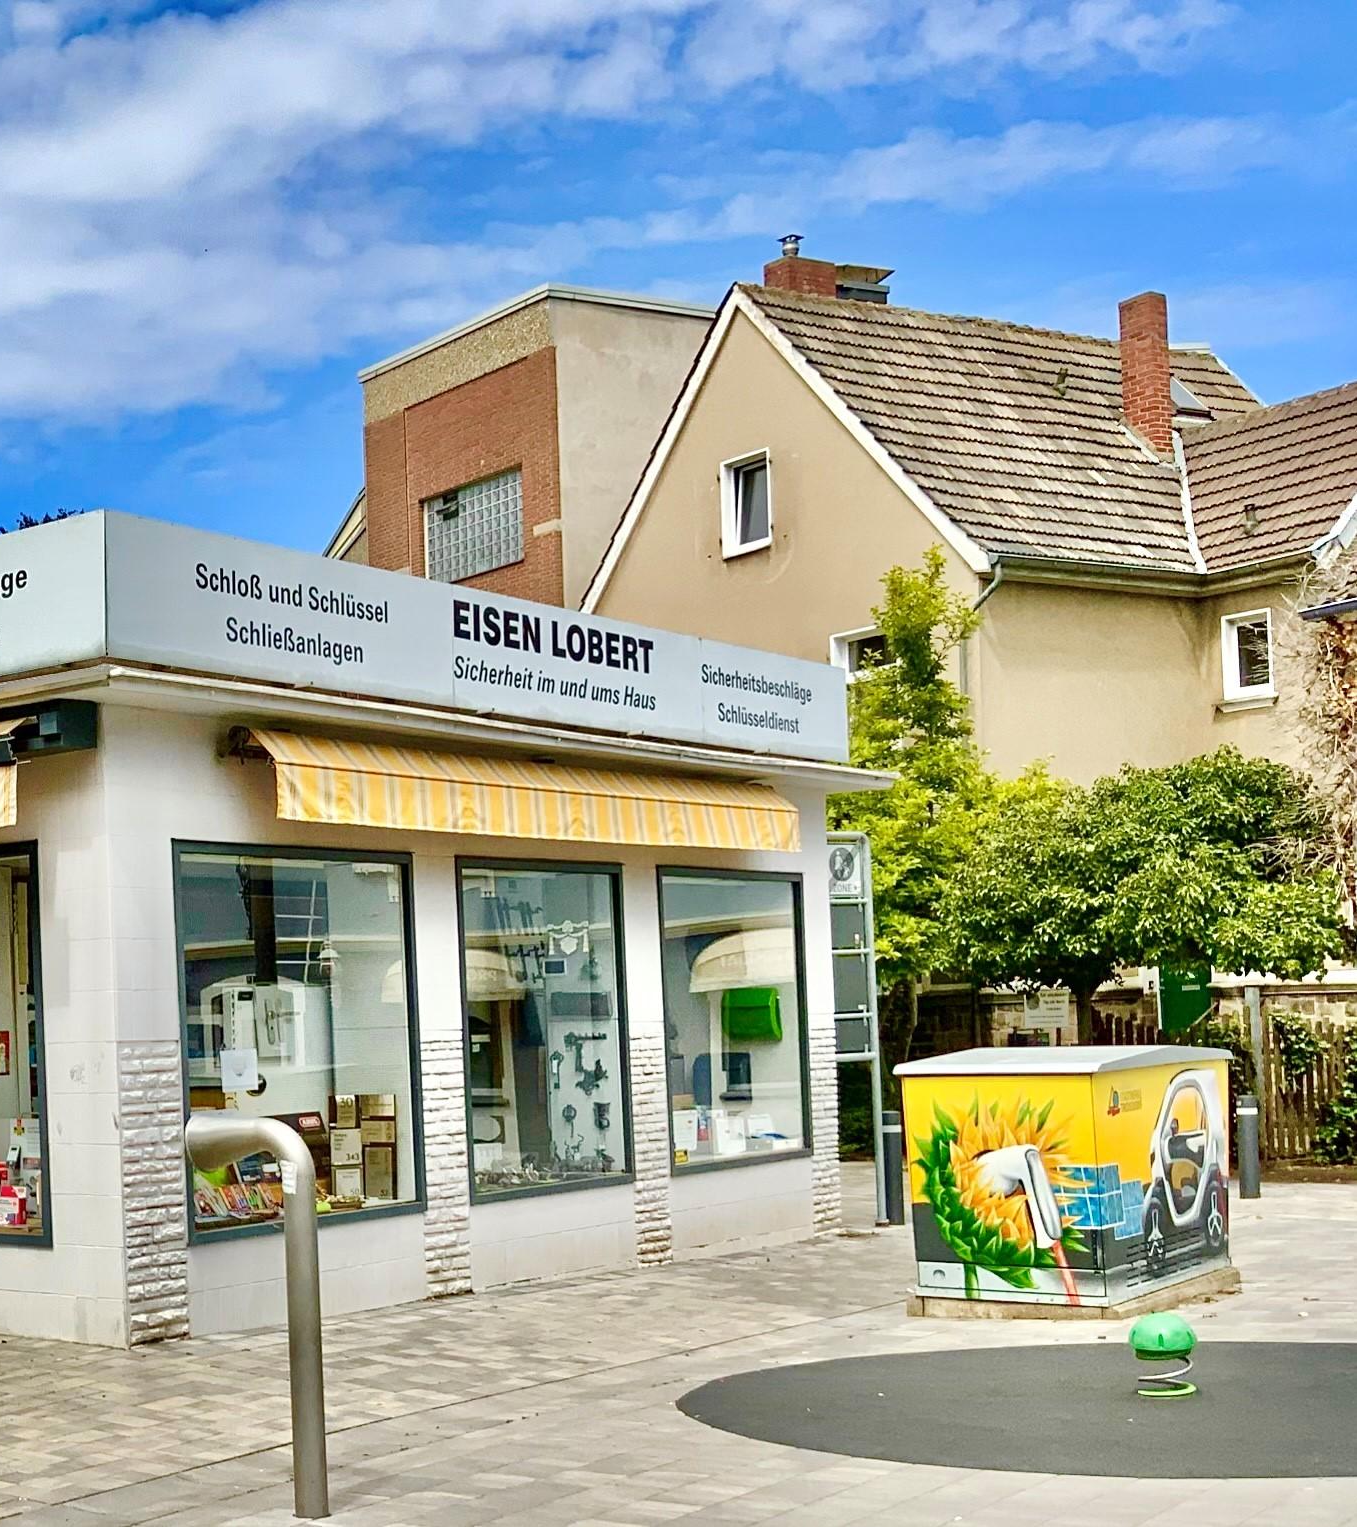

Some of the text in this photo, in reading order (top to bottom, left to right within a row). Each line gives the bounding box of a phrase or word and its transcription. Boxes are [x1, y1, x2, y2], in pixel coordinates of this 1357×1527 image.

[195, 563, 388, 623] Schloß und Schlüssel
[226, 617, 364, 666] Schließanlagen
[453, 599, 654, 674] EISEN LOBERT
[453, 655, 657, 711] Sicherheit im und ums Haus
[701, 663, 812, 705] Sicherheitsbeschläge
[717, 702, 800, 734] Schlüsseldienst
